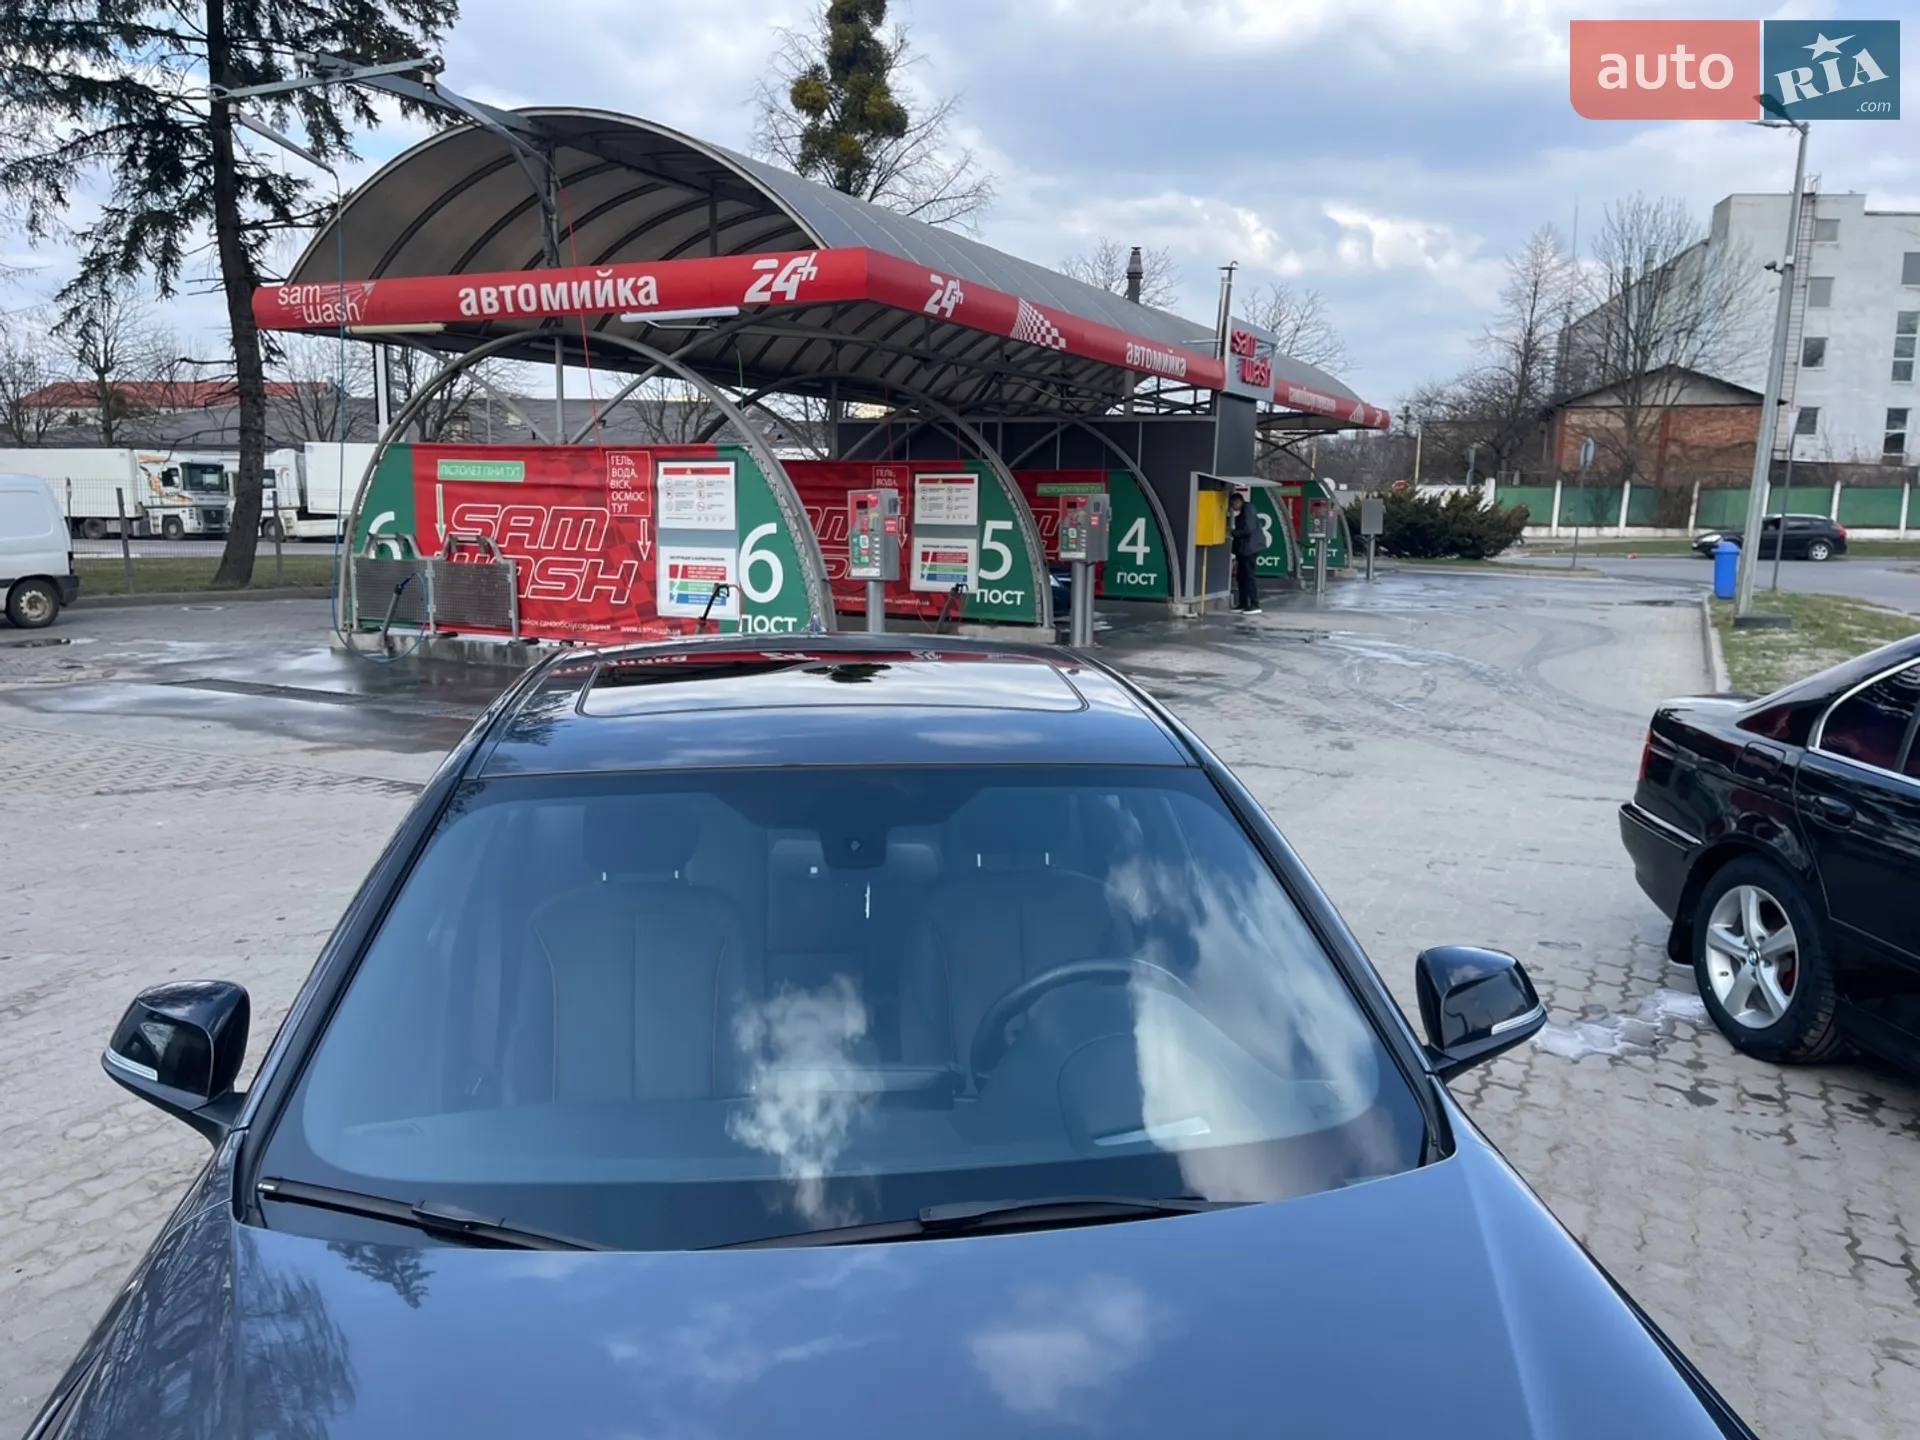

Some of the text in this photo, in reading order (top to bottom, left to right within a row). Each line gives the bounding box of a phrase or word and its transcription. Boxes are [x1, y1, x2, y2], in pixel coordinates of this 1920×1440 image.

[277, 284, 321, 305] sam
[459, 268, 659, 316] автомийка
[303, 297, 361, 325] wash
[1125, 342, 1187, 377] автомийка
[611, 491, 645, 502] ОСМОС
[611, 502, 629, 513] ТУТ
[451, 503, 610, 552] SAM
[979, 520, 1013, 580] 5
[1117, 517, 1150, 566] 4
[739, 522, 784, 604] 6
[1256, 556, 1281, 567] ОСТ
[1116, 572, 1157, 586] ПОСТ
[976, 589, 1025, 605] ПОСТ
[738, 614, 797, 633] ПОСТ
